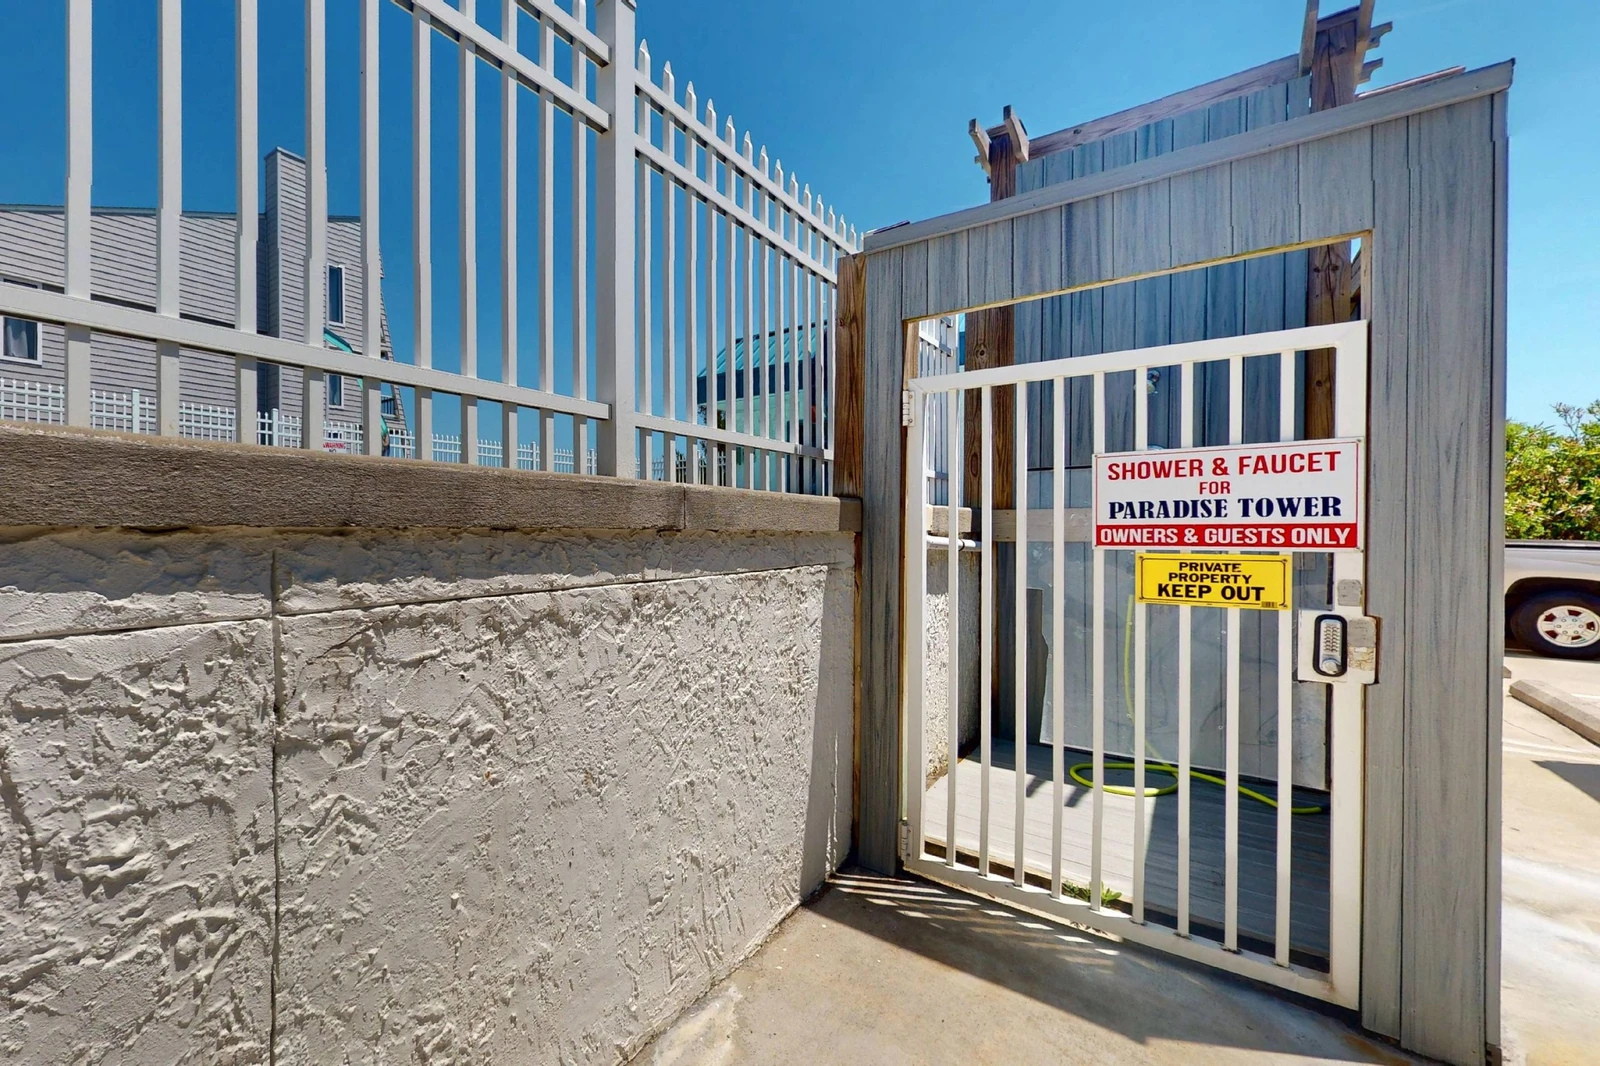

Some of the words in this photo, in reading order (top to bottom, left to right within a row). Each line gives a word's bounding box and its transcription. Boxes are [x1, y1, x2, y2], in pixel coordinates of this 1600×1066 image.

[1107, 459, 1203, 481] SHOWER
[1211, 457, 1230, 476] &
[1238, 451, 1341, 475] FAUCET
[1199, 481, 1231, 495] FOR
[1108, 499, 1228, 520] PARADISE
[1237, 496, 1342, 518] TOWER
[1100, 528, 1178, 544] OWNERS
[1183, 528, 1199, 543] &
[1204, 527, 1285, 545] GUESTS
[1290, 527, 1351, 545] ONLY
[1178, 562, 1242, 573] PRIVATE
[1168, 572, 1253, 584] PROPERTY
[1157, 583, 1212, 599] KEEP
[1220, 586, 1266, 602] OUT
